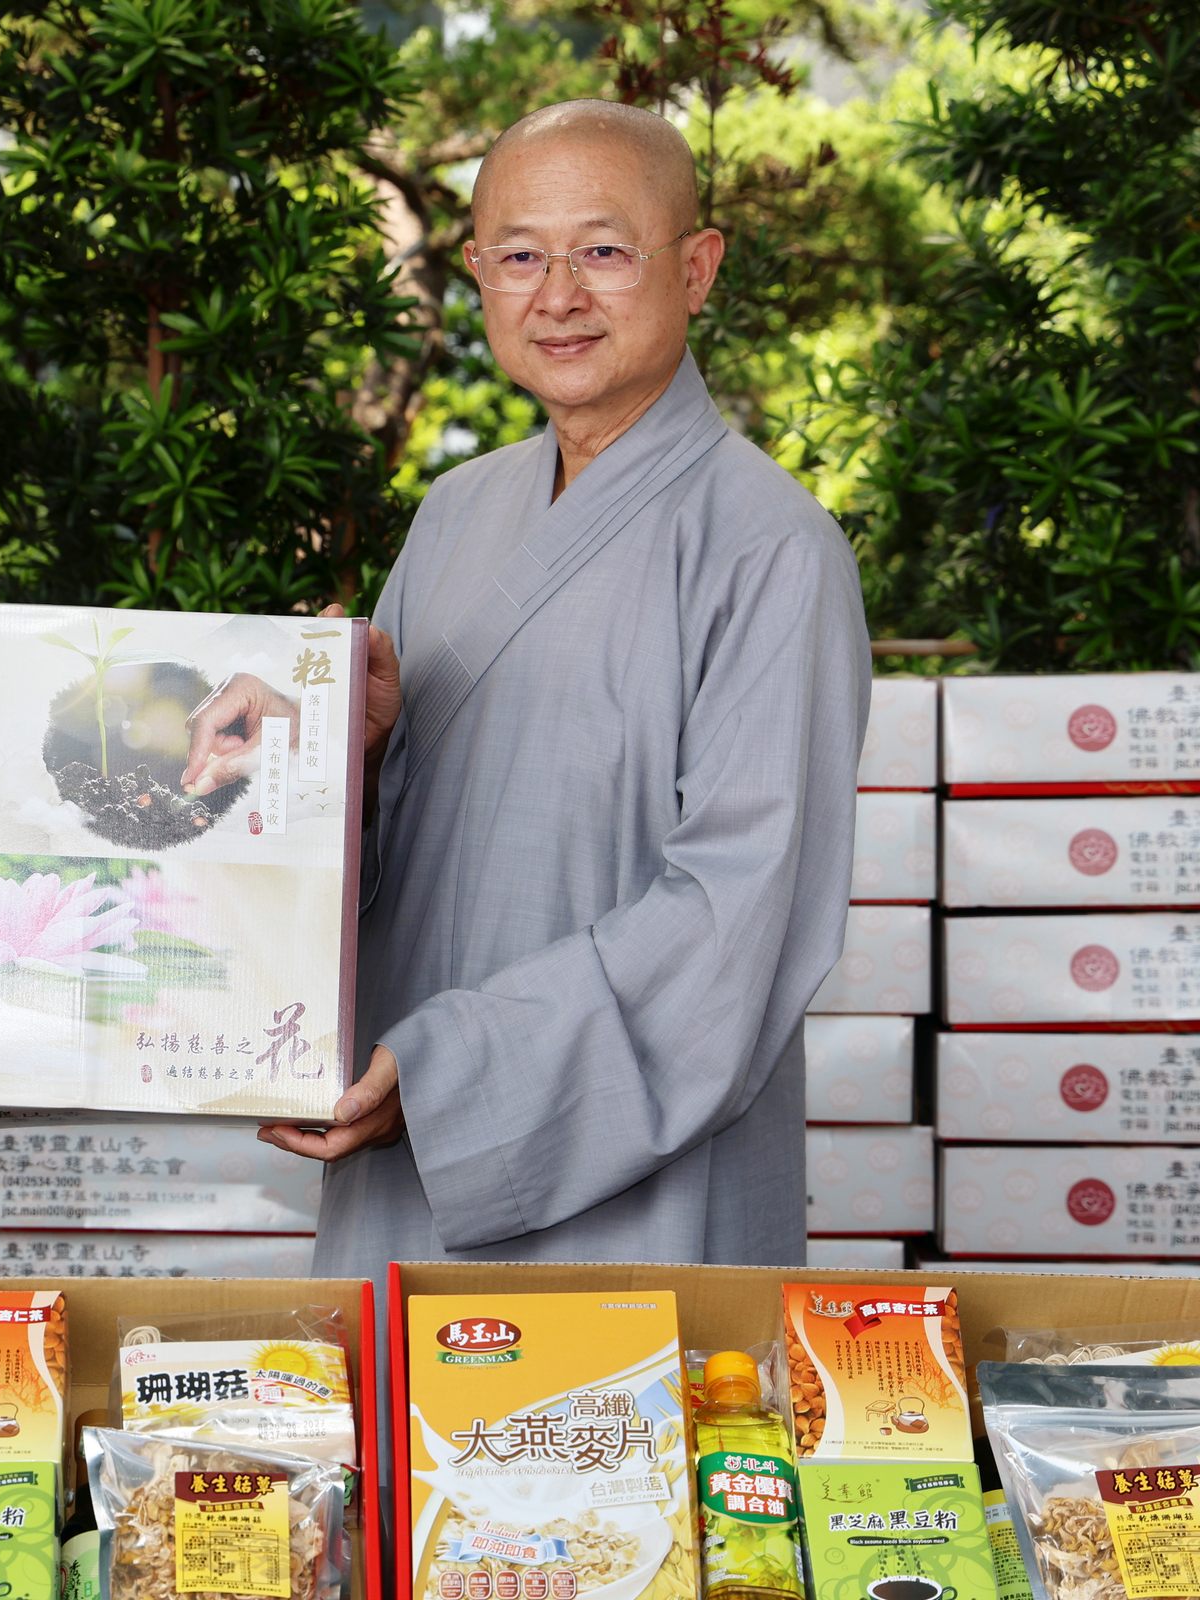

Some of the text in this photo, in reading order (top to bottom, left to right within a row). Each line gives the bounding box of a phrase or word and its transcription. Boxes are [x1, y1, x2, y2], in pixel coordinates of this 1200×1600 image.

[292, 630, 342, 689] 一粒
[306, 694, 321, 768] 落土百粒收
[860, 1302, 939, 1317] 高鈣杏仁茶
[446, 1322, 515, 1346] 馬玉山
[445, 1352, 513, 1364] GREENMAX
[136, 1369, 249, 1404] 珊瑚菇
[571, 1391, 634, 1418] 高纖
[450, 1413, 657, 1473] 大燕麥片
[742, 1458, 779, 1475] 北斗
[709, 1473, 793, 1503] 黃金優質
[726, 1494, 785, 1517] 調合油
[830, 1510, 956, 1529] 黑芝麻黑豆粉
